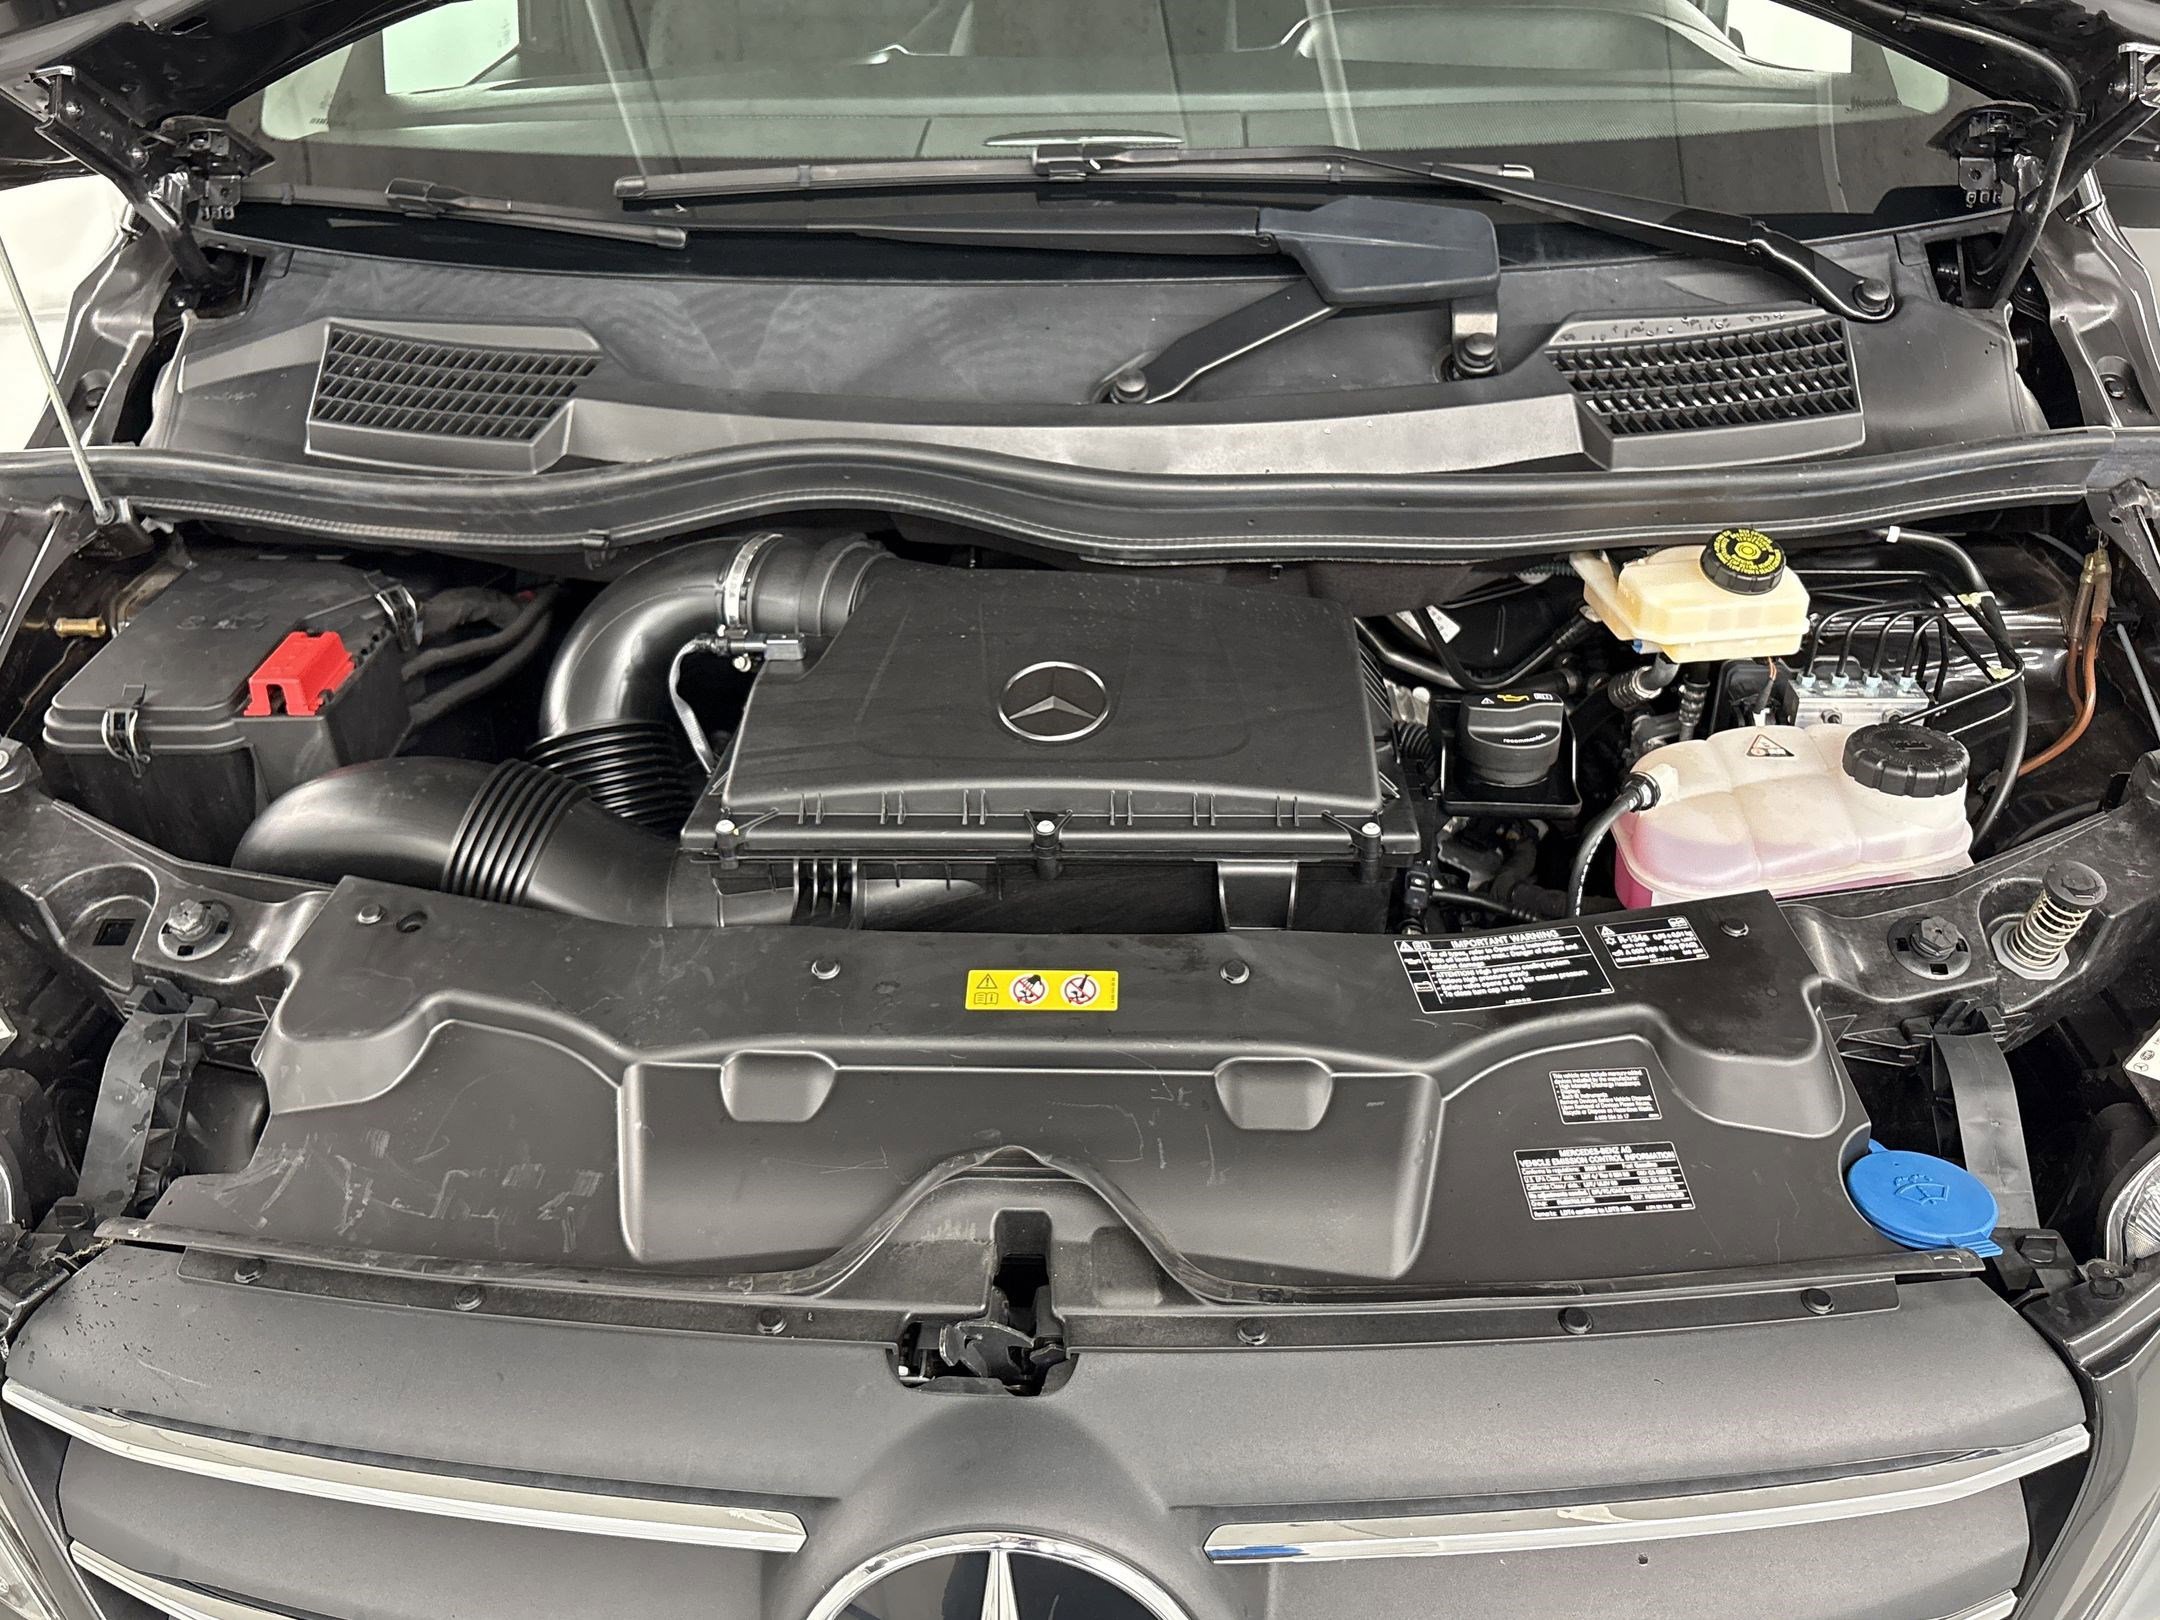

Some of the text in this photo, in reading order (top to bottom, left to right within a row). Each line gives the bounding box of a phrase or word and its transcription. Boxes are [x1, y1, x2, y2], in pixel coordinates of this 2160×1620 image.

[1451, 930, 1558, 948] IMPORTANT WARNING
[1617, 934, 1649, 943] R-134a
[1493, 944, 1525, 952] Operating
[1525, 940, 1564, 948] Instructions
[1510, 949, 1533, 957] Danger
[1441, 984, 1462, 992] Safety
[1559, 970, 1588, 979] pressure
[1479, 974, 1507, 982] pressure
[1559, 1147, 1618, 1156] MERCEDES-BENZ
[1519, 1151, 1674, 1167] VEHICLE EMISSION CONTROL INFORMATION
